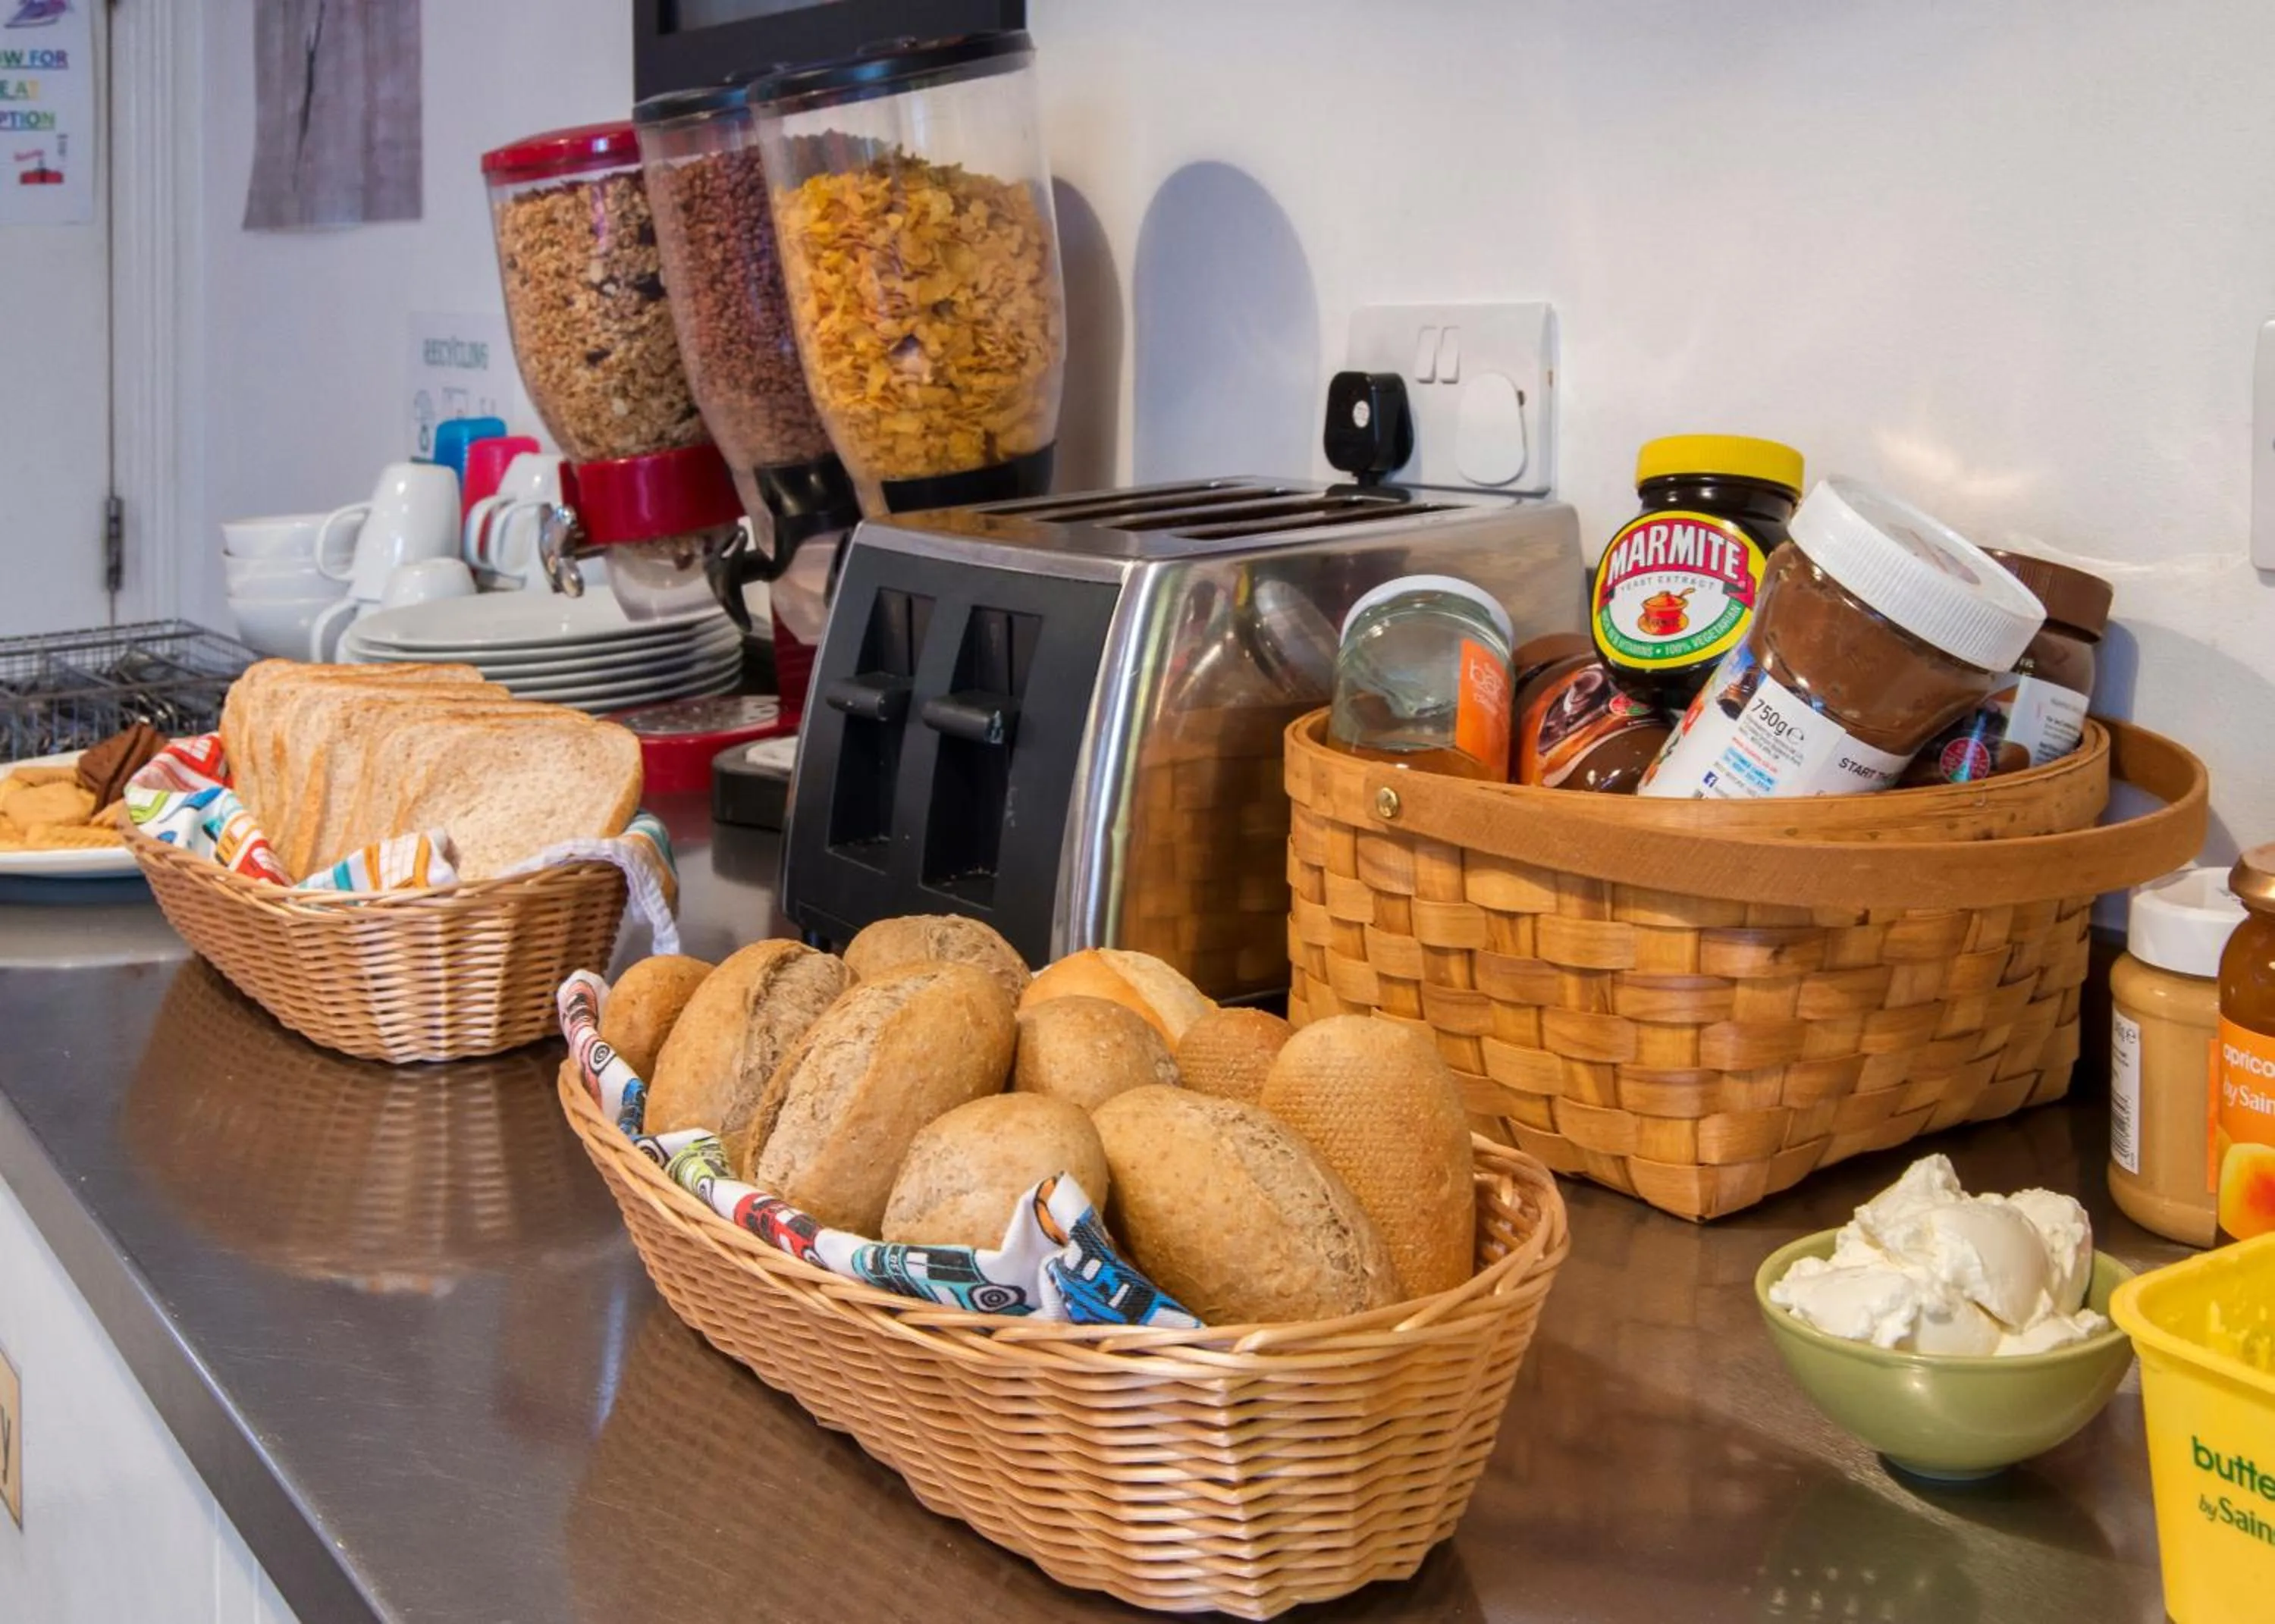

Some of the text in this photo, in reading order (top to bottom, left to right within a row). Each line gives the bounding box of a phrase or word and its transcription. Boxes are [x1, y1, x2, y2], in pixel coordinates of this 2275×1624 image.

[0, 49, 69, 70] W FOR
[1607, 524, 1740, 586] MARMITE
[1621, 575, 1715, 591] YEAST EXTRACT
[1666, 643, 1689, 656] 100%
[1692, 604, 1743, 648] VEGETARIAN
[1750, 698, 1788, 737] 750g
[1839, 757, 1878, 778] START
[2223, 1042, 2275, 1078] aprico
[2223, 1074, 2275, 1115] by Sain
[2192, 1435, 2275, 1502] butte
[2199, 1494, 2275, 1546] by Sain
